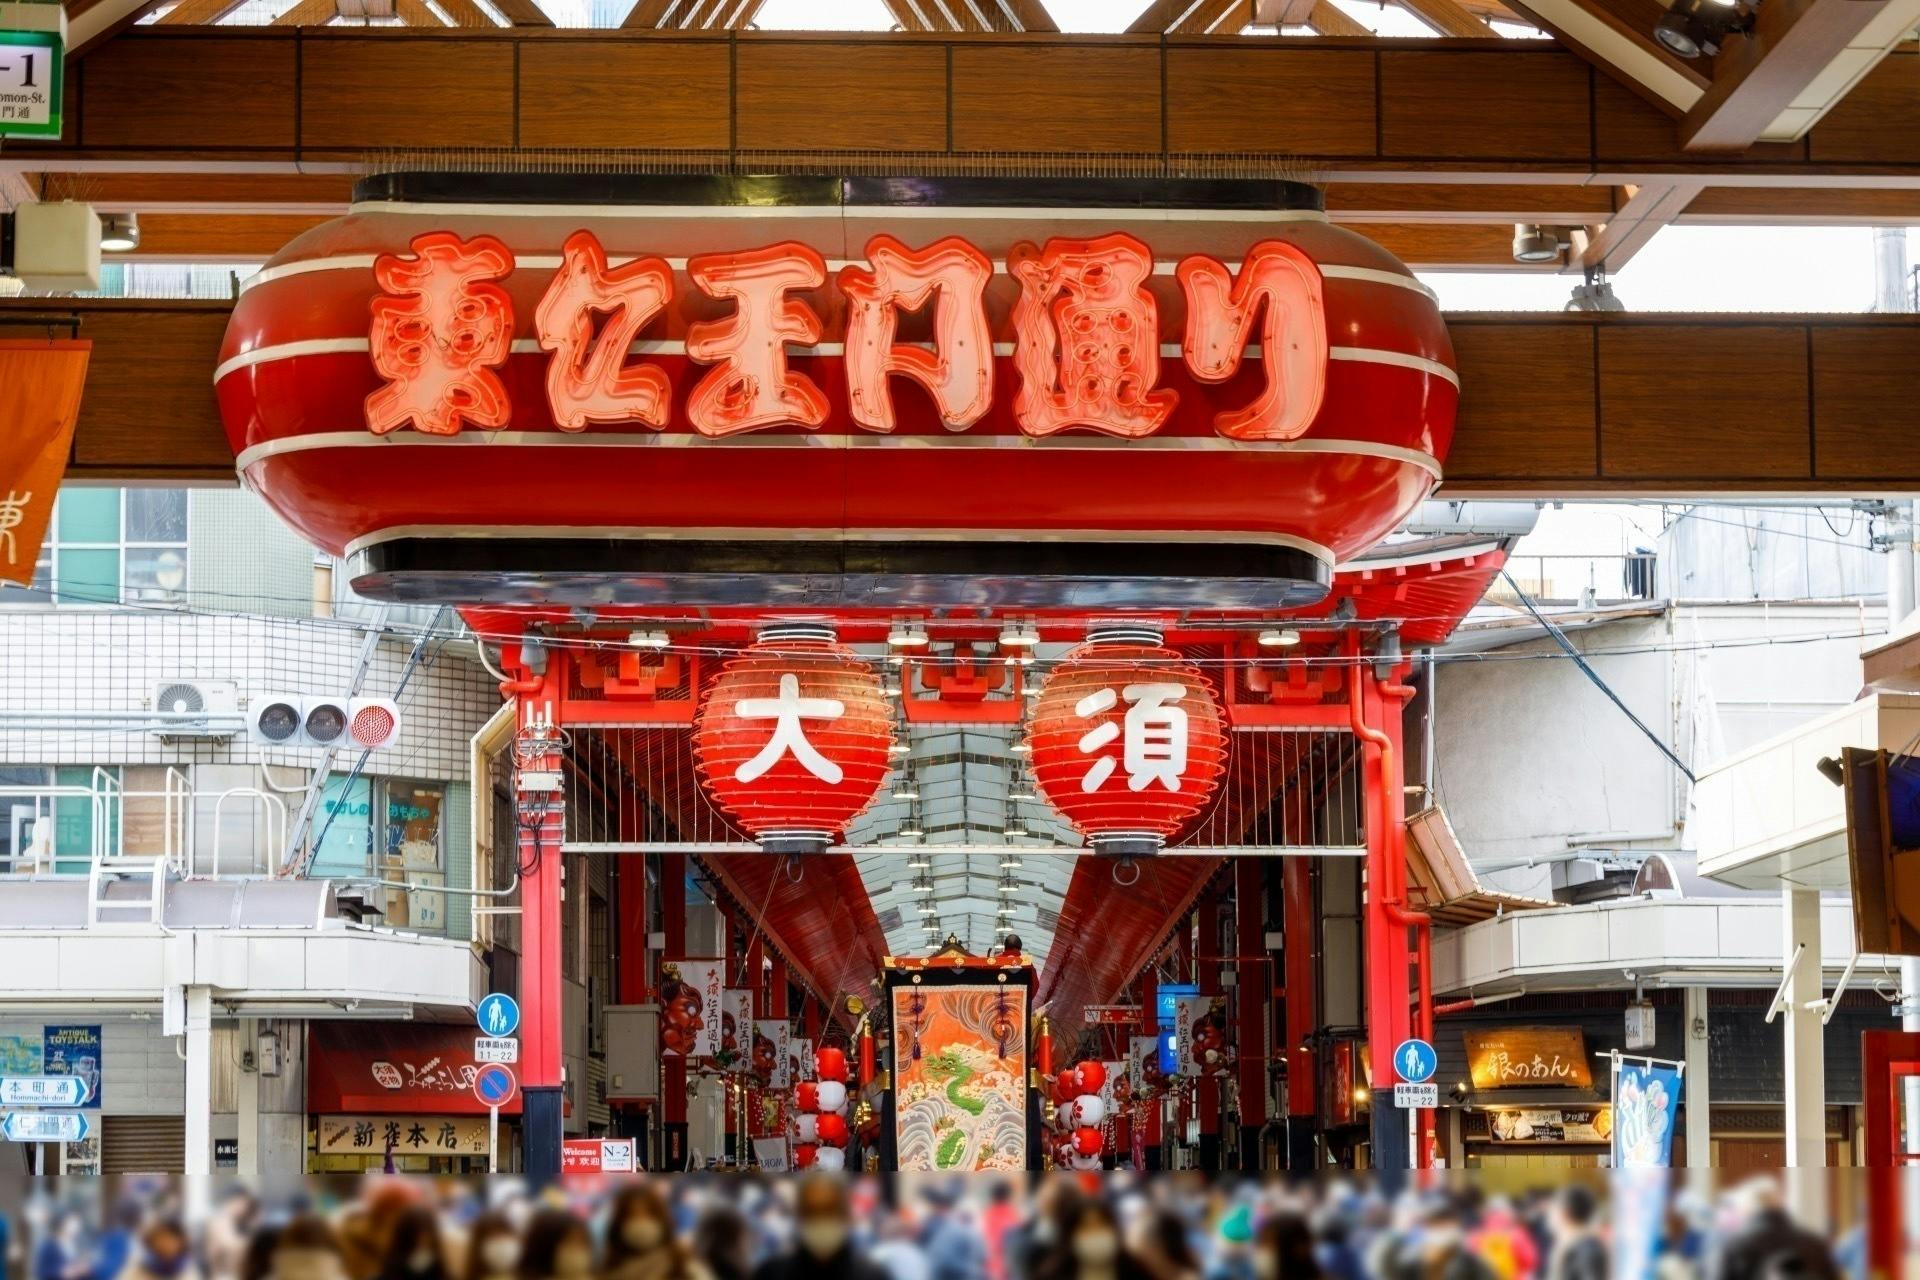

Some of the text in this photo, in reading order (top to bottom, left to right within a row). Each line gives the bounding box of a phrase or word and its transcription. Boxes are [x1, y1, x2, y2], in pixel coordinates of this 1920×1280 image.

[735, 673, 845, 785] 大
[1075, 682, 1188, 793] 須
[706, 968, 720, 1052] 大須仁王門通り
[739, 995, 751, 1069] 大須仁王門通り
[1178, 1001, 1190, 1074] 大須仁王門通り
[9, 1081, 69, 1094] 本町通
[10, 1094, 66, 1102] Hommachi-dori
[353, 1121, 459, 1149] 新雀本店
[563, 1147, 597, 1156] Welcome
[604, 1145, 630, 1157] N-2
